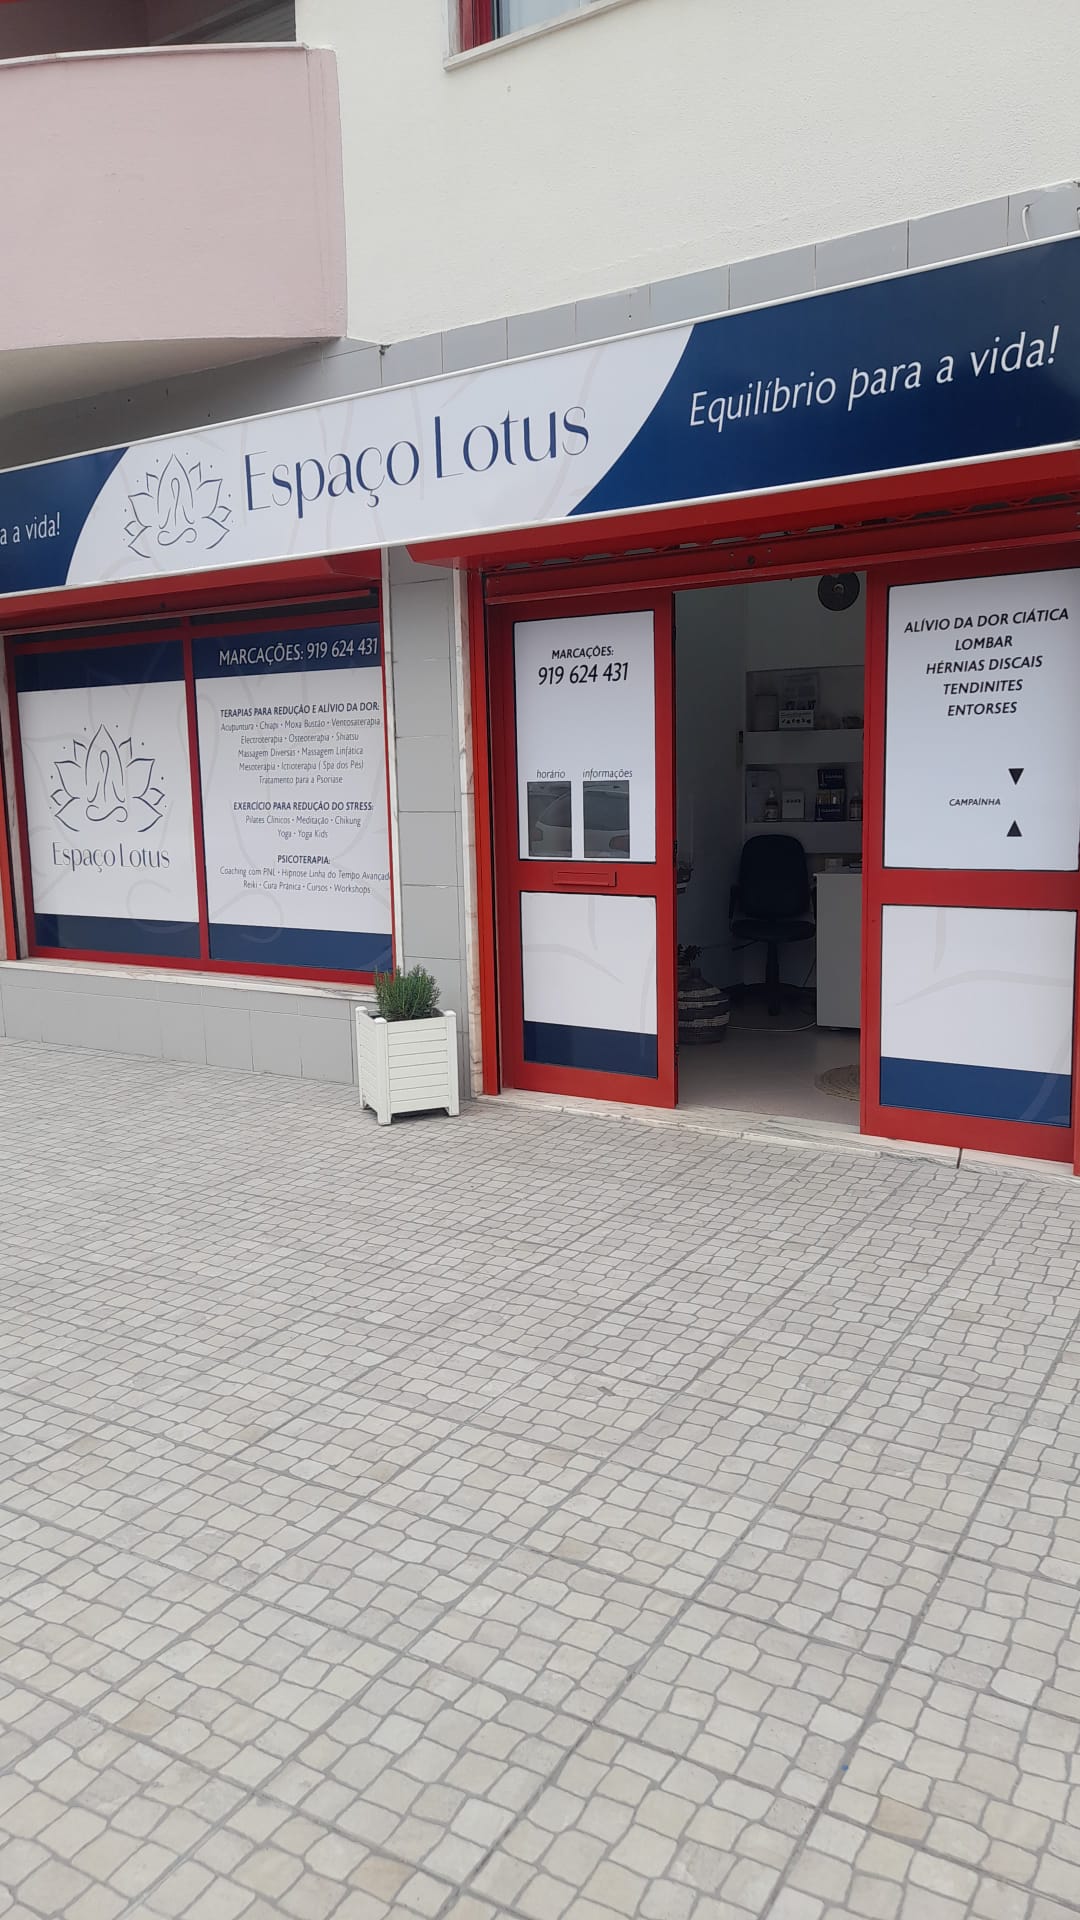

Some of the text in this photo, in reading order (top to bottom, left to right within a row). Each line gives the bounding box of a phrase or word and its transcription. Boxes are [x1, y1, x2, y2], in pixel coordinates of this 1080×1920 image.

[690, 325, 1060, 432] Equilíbrio para a vida!
[245, 406, 590, 518] Espaço Lotus
[12, 526, 20, 543] a
[25, 511, 60, 540] vida!
[904, 607, 1069, 634] ALÍVIO DA DOR CIÁTICA
[219, 637, 378, 666] MARCAÇÕES: 919 624 431
[955, 635, 1013, 651] LOMBAR
[551, 645, 614, 660] MARCAÇÕES:
[926, 655, 1044, 675] HÉRNIAS DISCAIS
[538, 662, 629, 686] 919 624 431
[943, 678, 1024, 695] TENDINITES
[220, 702, 380, 718] TERAPIAS PARA REDUÇÃO E ALÍVIO DA DOR:
[947, 701, 1018, 717] ENTORSES
[536, 769, 566, 779] horário
[582, 768, 633, 780] informações
[233, 800, 272, 811] EXERCÍCIO
[273, 801, 292, 811] PARA
[293, 800, 330, 812] REDUÇÃO
[331, 801, 345, 811] DO
[53, 842, 170, 873] Espaço Lotus
[362, 871, 390, 882] Avançad
